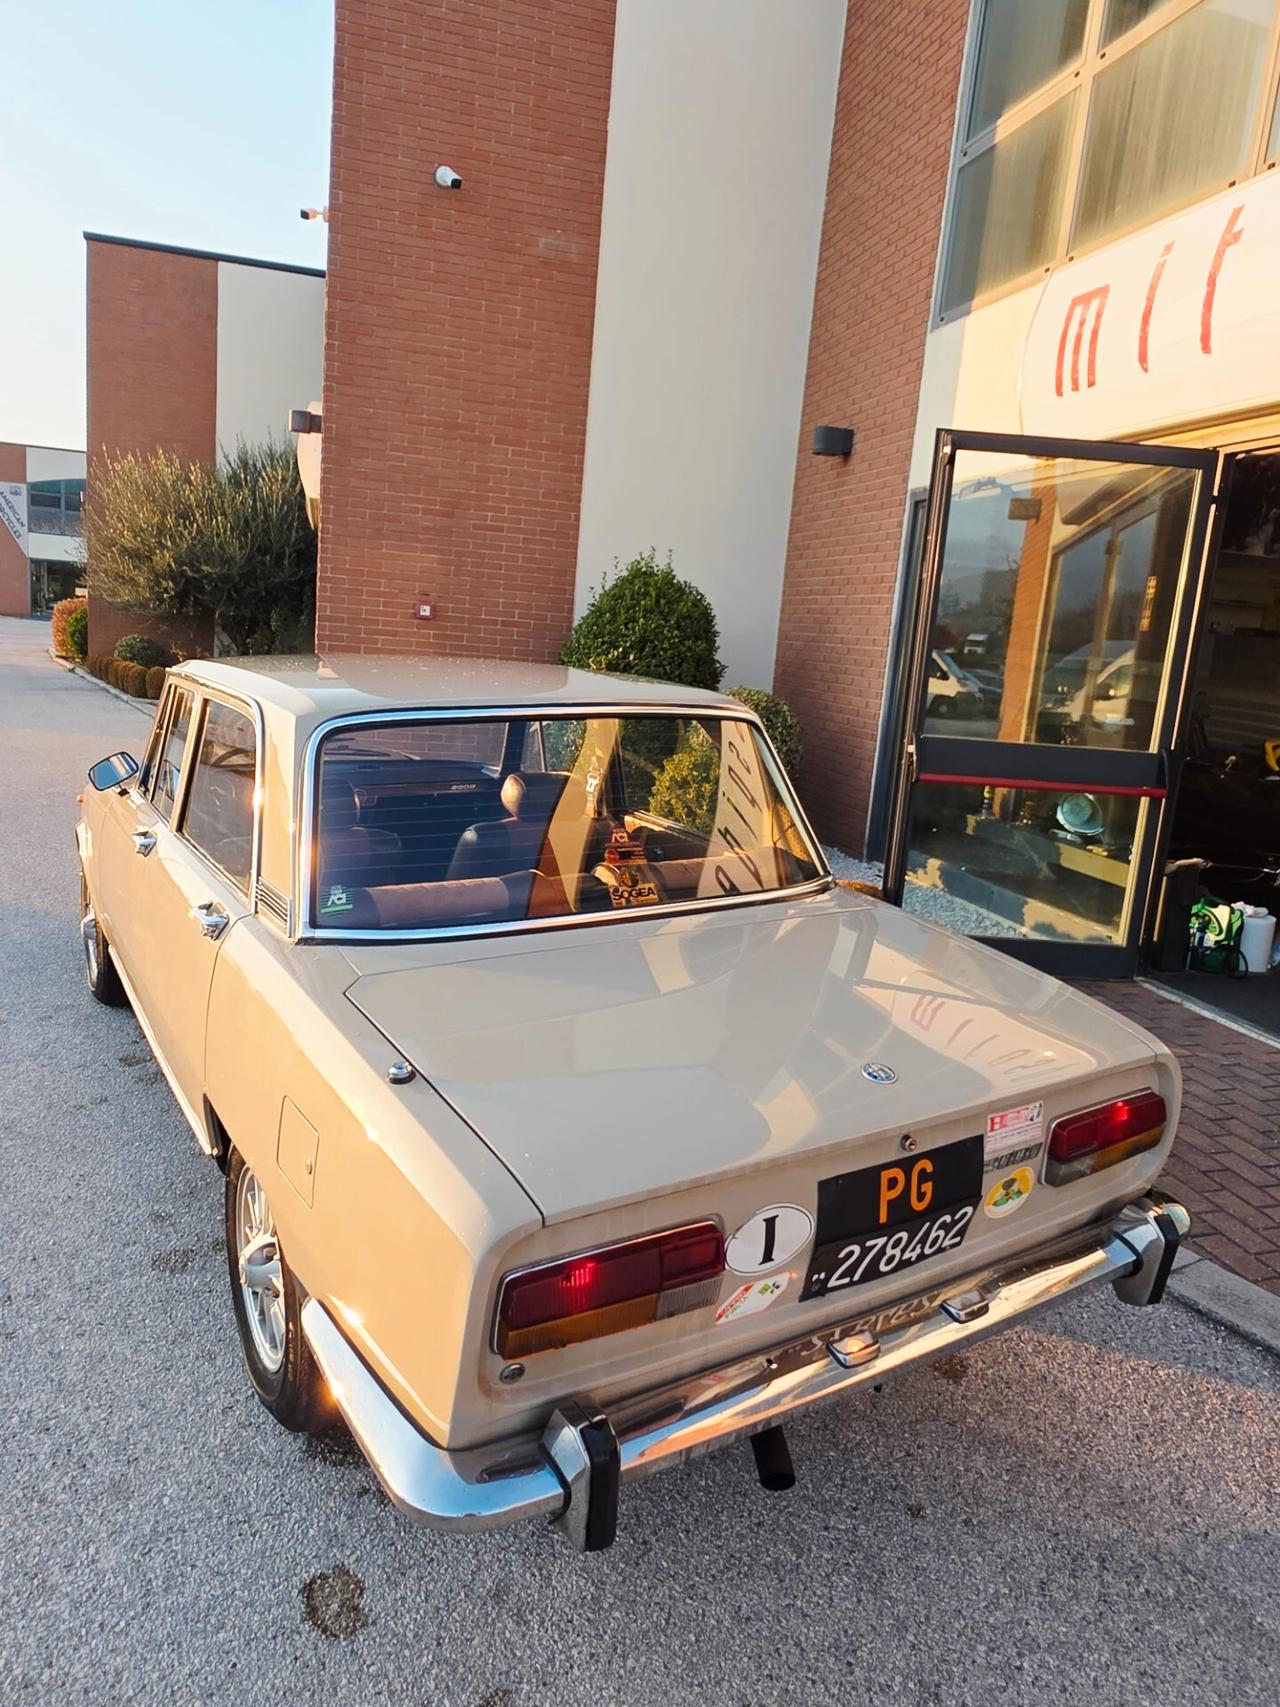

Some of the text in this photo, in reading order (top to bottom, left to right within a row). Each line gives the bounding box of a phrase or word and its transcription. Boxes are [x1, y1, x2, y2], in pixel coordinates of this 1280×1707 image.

[612, 886, 656, 901] SOGEA
[877, 1157, 934, 1225] PG
[757, 1213, 780, 1266] I
[827, 1204, 975, 1289] 278462
